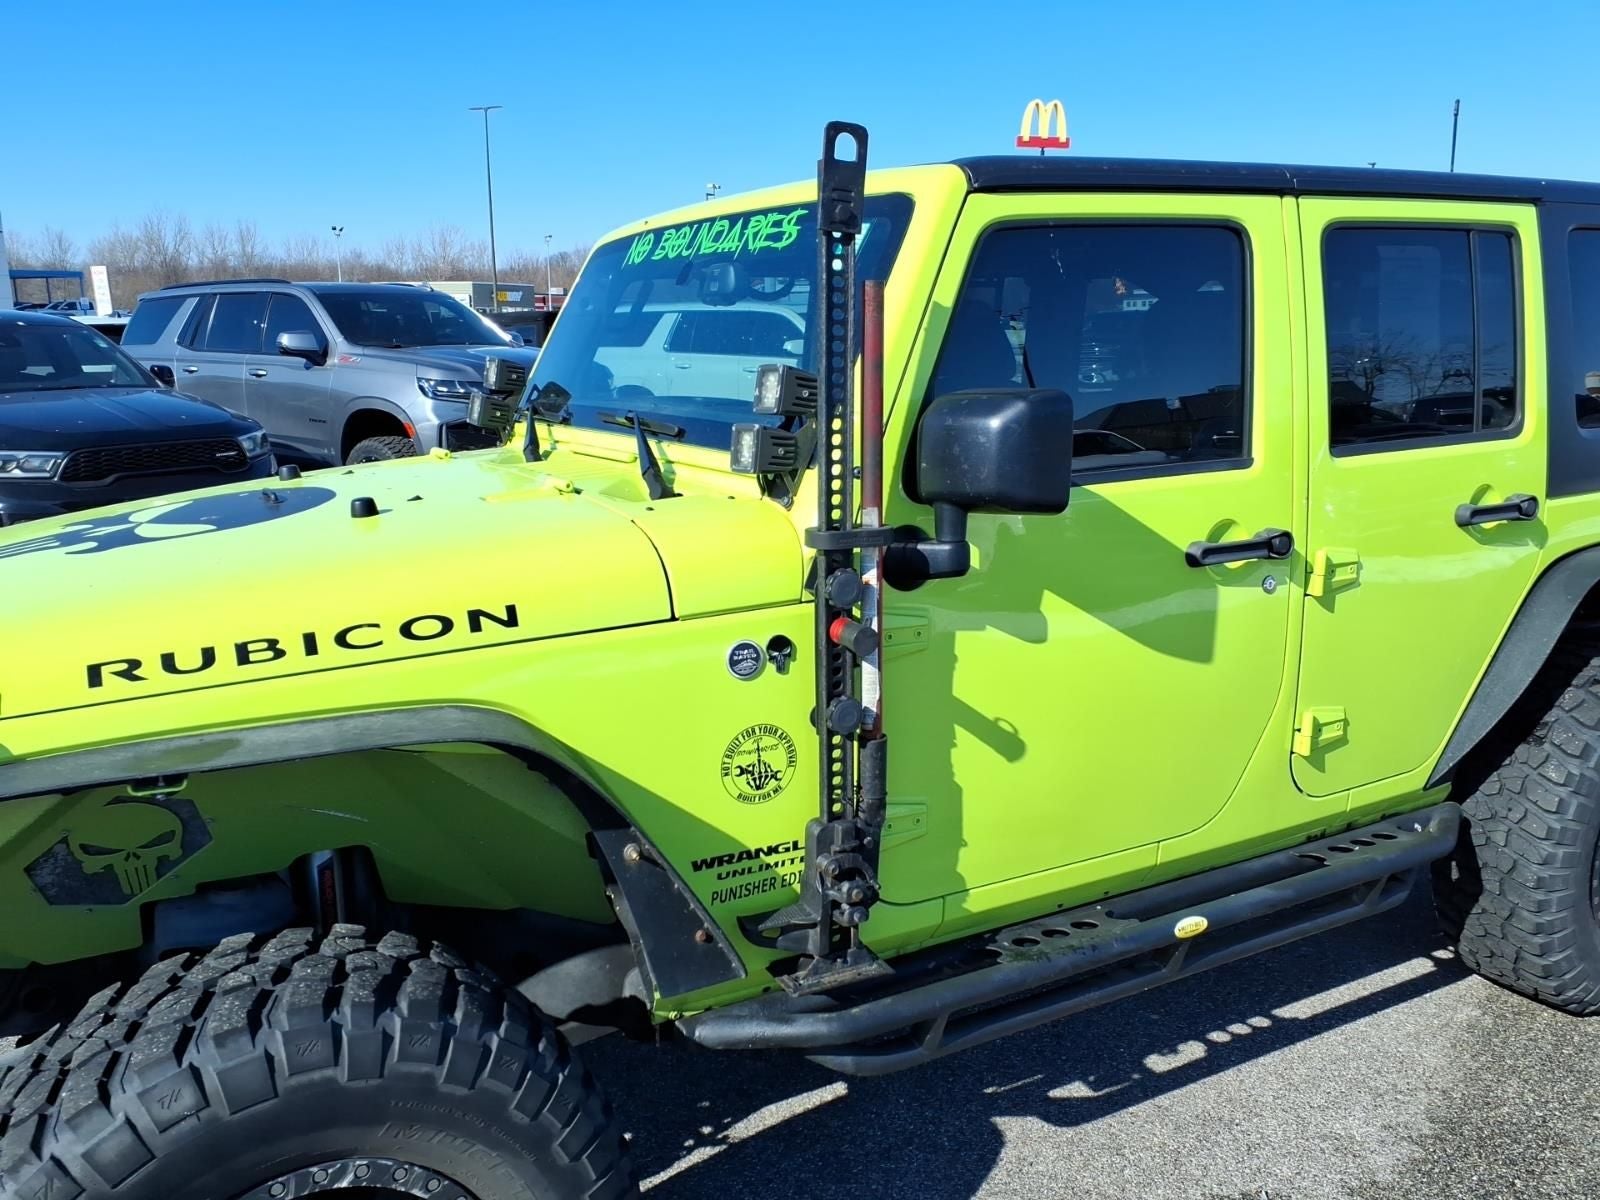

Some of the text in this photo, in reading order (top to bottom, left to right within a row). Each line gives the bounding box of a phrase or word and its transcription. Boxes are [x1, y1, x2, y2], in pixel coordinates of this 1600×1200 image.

[621, 208, 809, 270] NO BOUNDARIES
[86, 603, 520, 689] RUBICON
[722, 725, 796, 778] NOT BUILT FOR YOUR APPROVAL
[736, 784, 784, 803] BUILT FOR ME
[711, 875, 777, 906] PUNISHER
